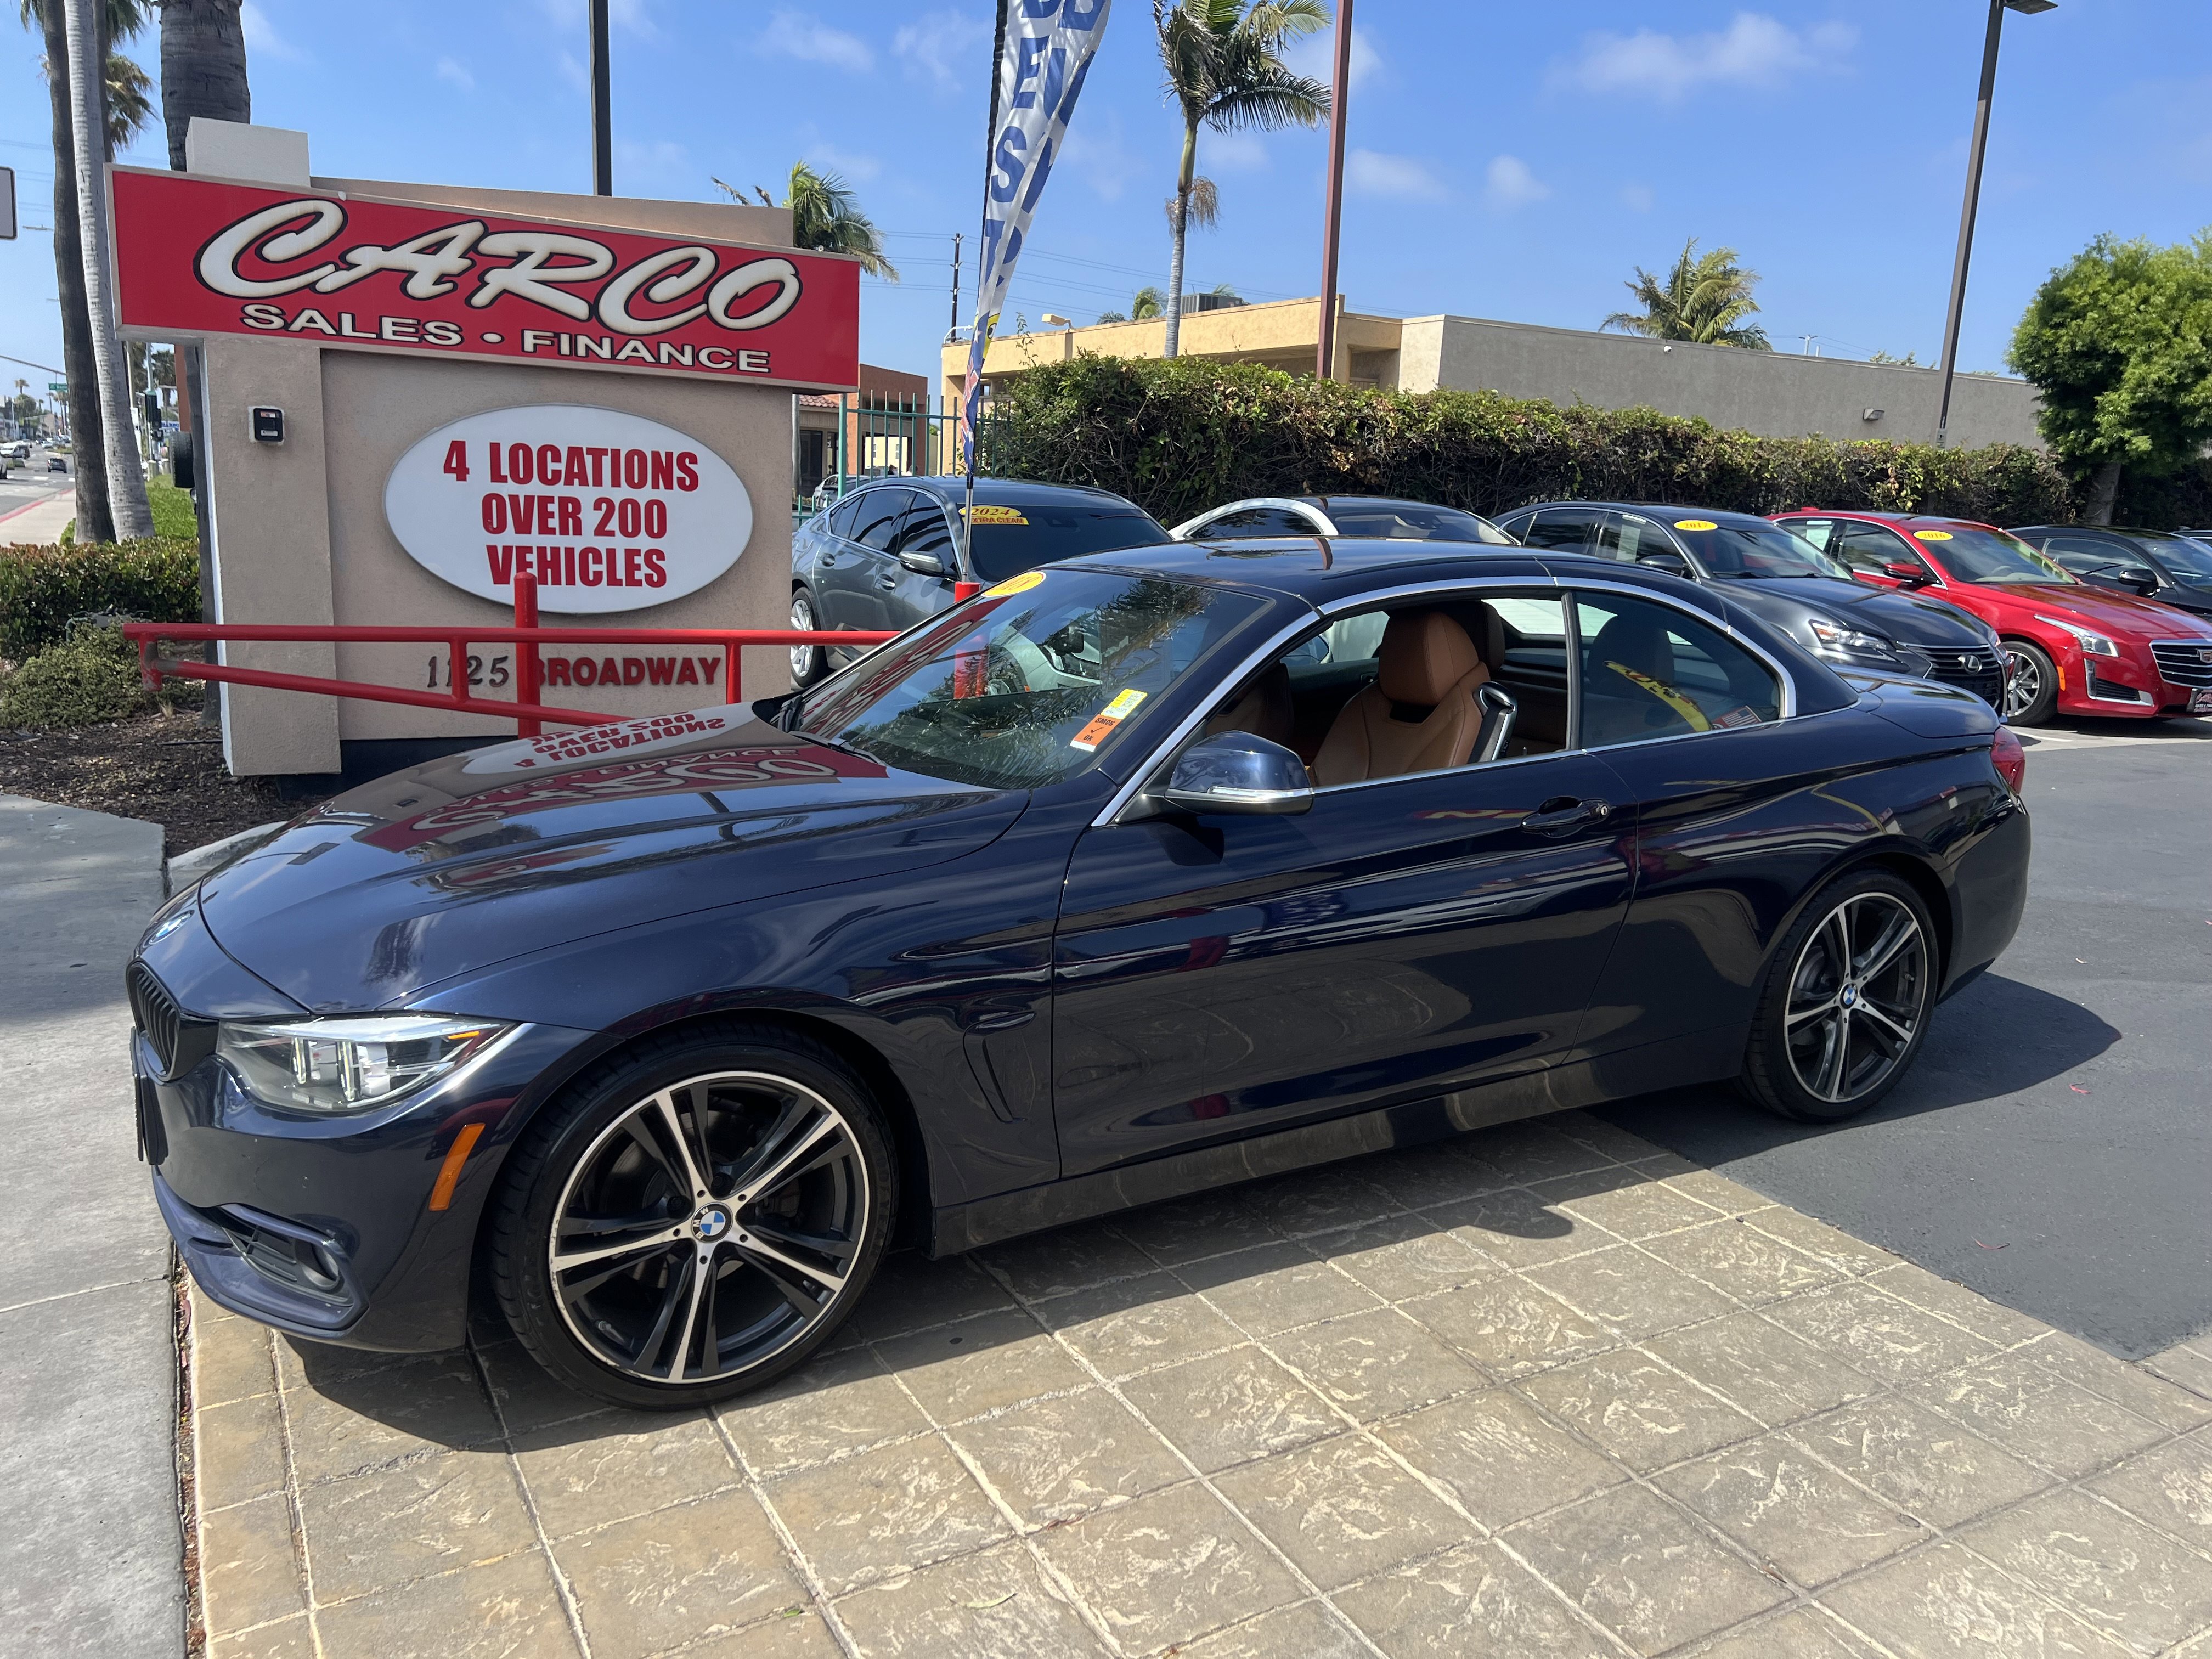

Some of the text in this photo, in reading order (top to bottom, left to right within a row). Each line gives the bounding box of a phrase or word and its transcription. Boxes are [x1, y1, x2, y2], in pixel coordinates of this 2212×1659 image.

[193, 198, 803, 336] CARCO
[240, 303, 771, 373] SALES FINANCE
[443, 440, 699, 492] 4 LOCATIONS
[482, 493, 667, 539] OVER 200
[972, 507, 1011, 516] 2024
[486, 545, 667, 588] VEHICLES
[1095, 717, 1115, 726] SMOG
